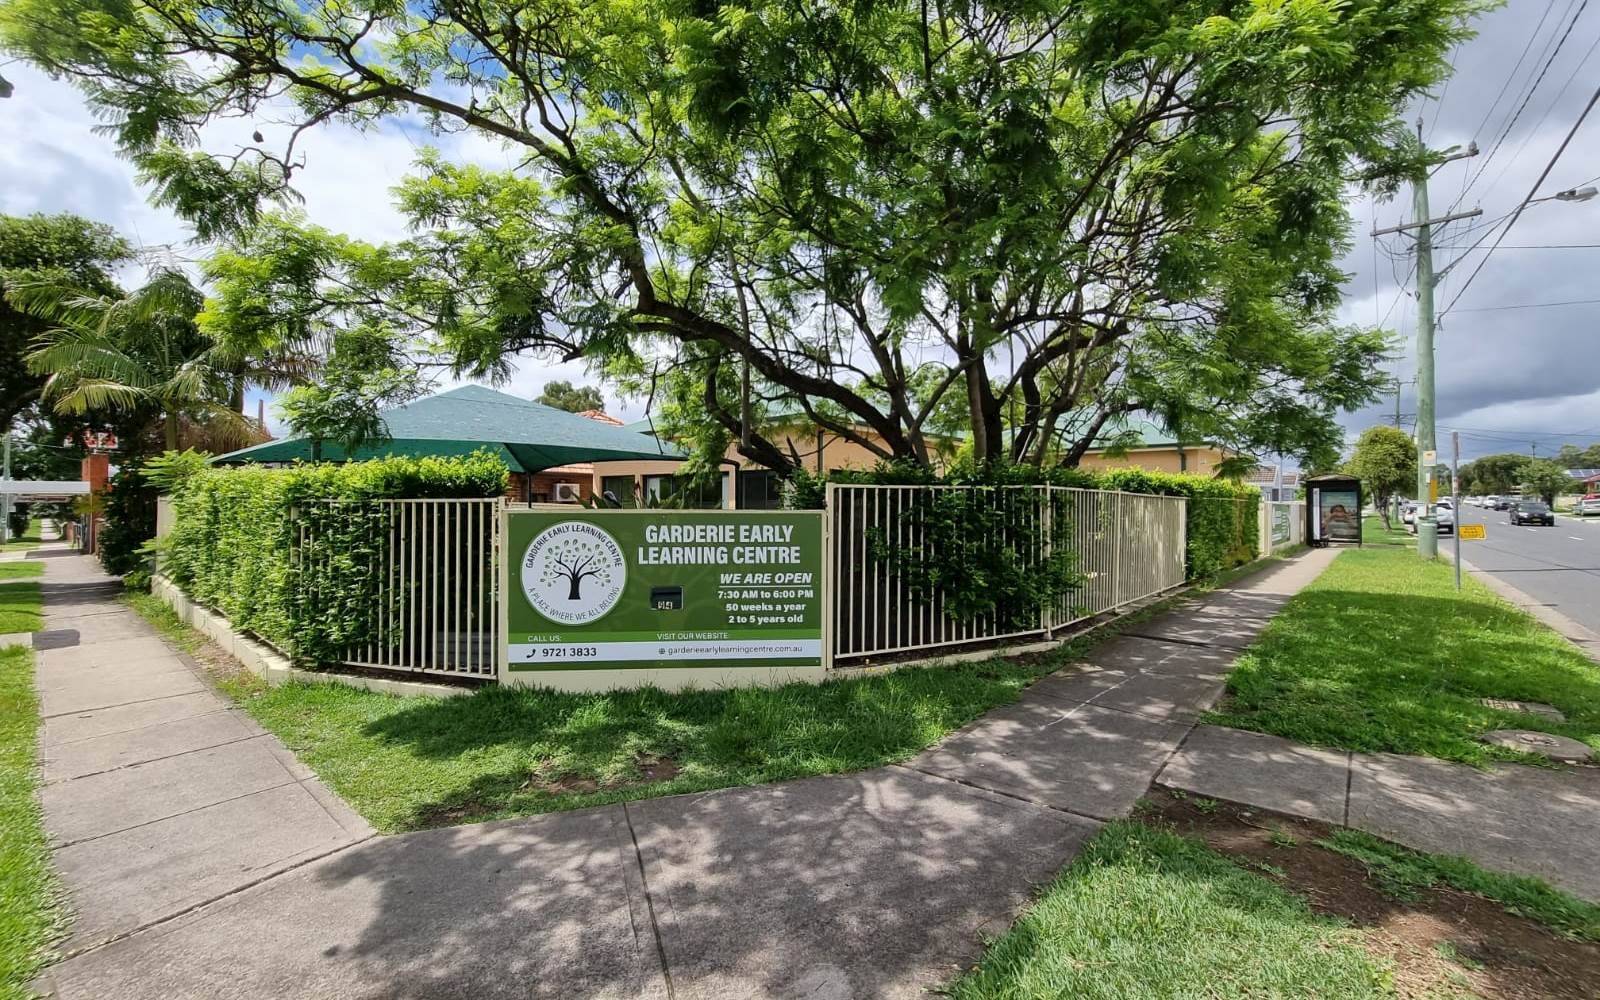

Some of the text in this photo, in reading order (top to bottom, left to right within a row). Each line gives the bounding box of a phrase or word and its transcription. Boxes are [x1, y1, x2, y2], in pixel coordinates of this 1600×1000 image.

[645, 524, 794, 543] GARDERIE EARLY
[525, 524, 623, 568] GARDERIE EARLY LEARNING CENTRE
[638, 546, 801, 565] LEARNING CENTRE
[720, 572, 812, 584] WE ARE OPEN
[717, 590, 814, 599] 7:30 AM to 6:00 PM
[725, 603, 739, 611] 50
[740, 602, 774, 611] weeks
[783, 603, 806, 612] year
[549, 608, 574, 620] WHERE
[575, 612, 588, 620] WE
[588, 607, 600, 617] ALL
[728, 614, 804, 625] 2 to 5 years old
[677, 632, 694, 640] OUR
[542, 647, 597, 657] 9721 3833
[668, 645, 803, 656] garderieearlylearningcentre.com.au
